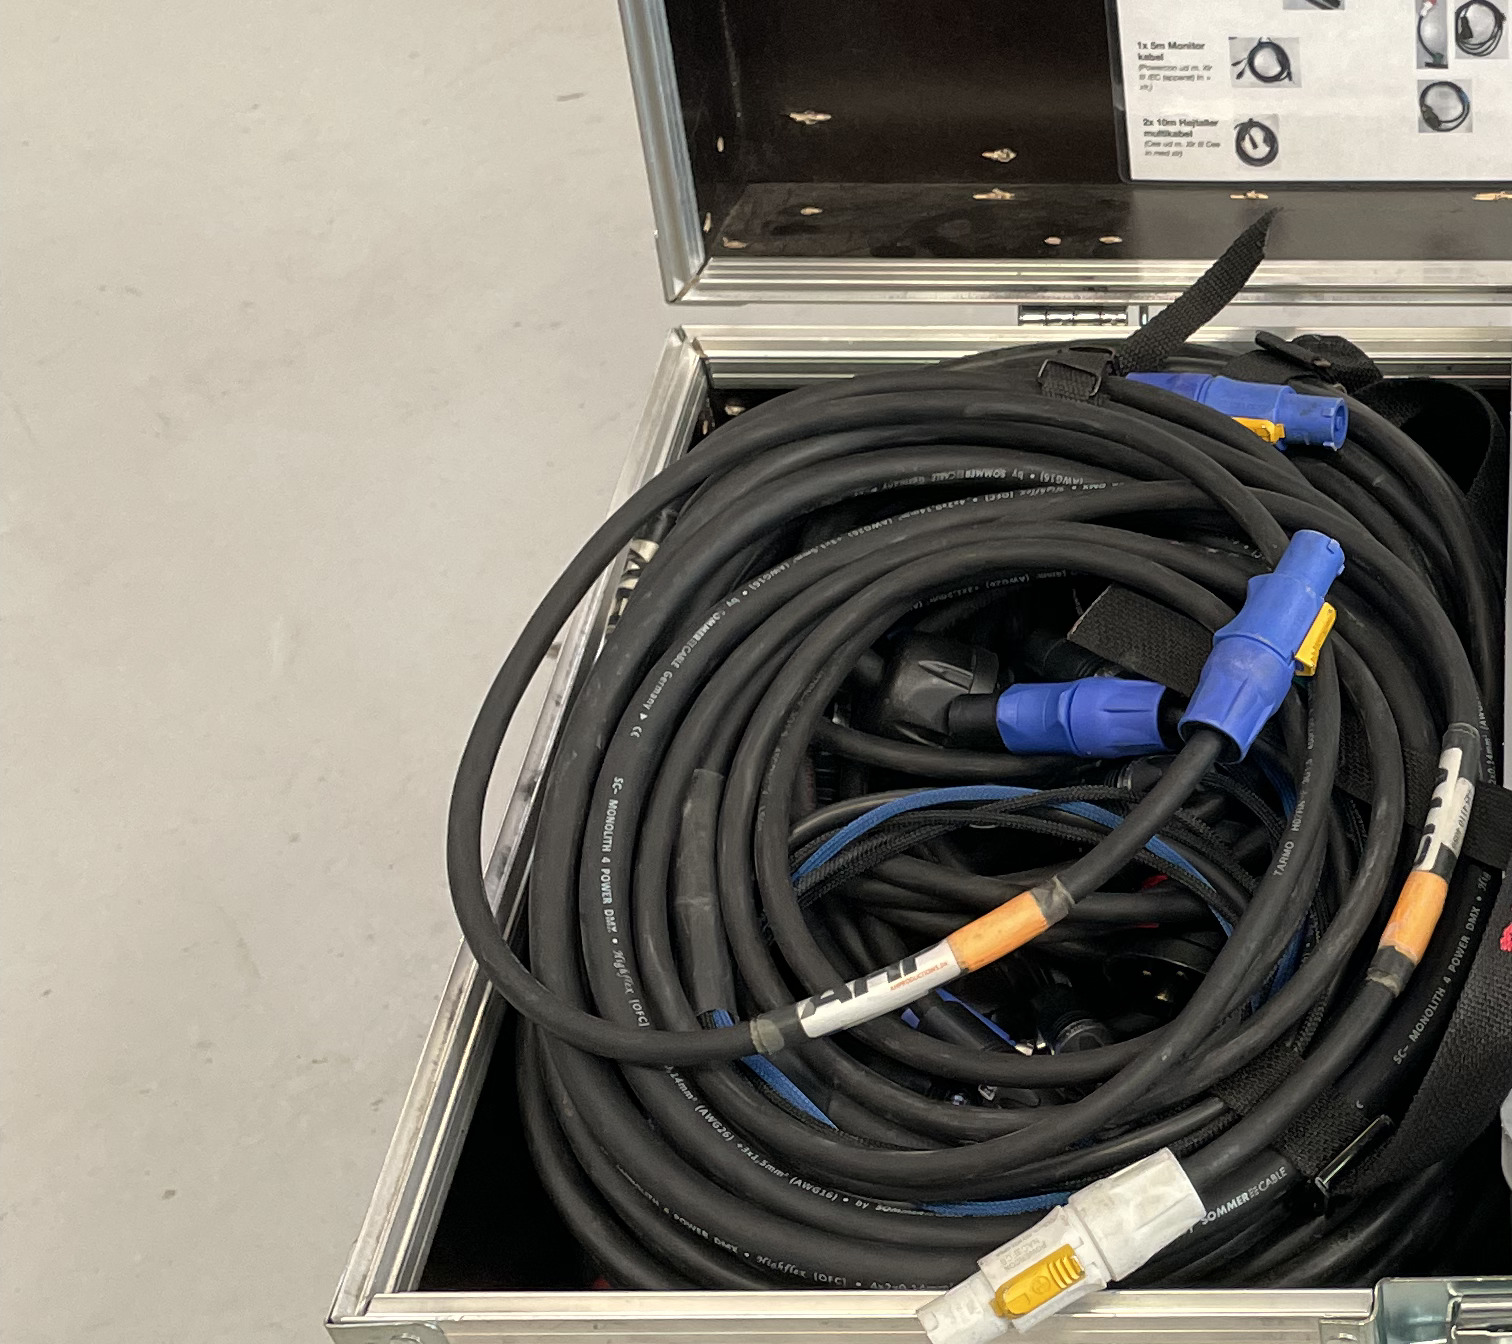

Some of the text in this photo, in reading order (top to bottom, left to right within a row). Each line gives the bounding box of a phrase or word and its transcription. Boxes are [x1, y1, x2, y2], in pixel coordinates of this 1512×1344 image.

[1167, 41, 1206, 49] Monitor
[601, 798, 618, 852] MONOLITH
[600, 868, 612, 905] POWER
[1408, 987, 1447, 1042] MONOLITH
[1446, 929, 1470, 973] POWER
[1465, 901, 1482, 926] DMX
